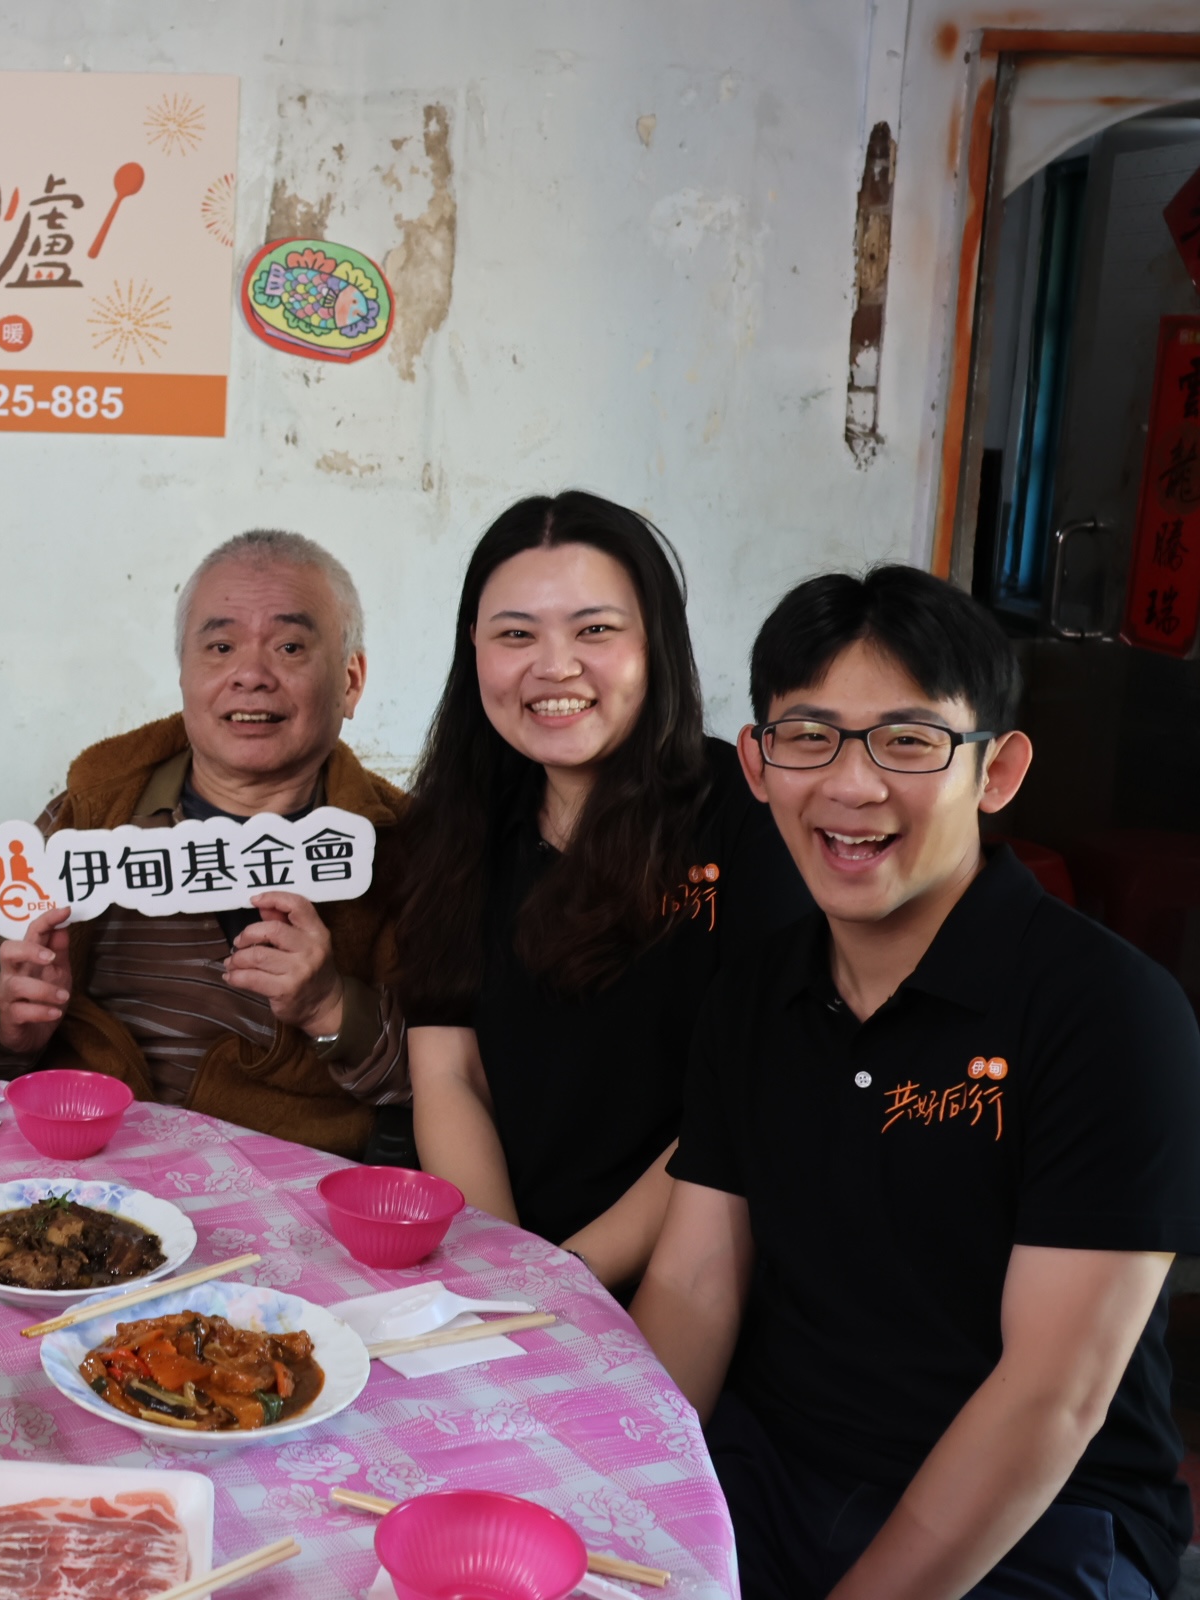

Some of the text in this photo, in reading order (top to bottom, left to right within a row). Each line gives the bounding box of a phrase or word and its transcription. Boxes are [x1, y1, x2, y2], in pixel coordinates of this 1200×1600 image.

[58, 827, 356, 903] 伊甸基金會
[971, 1060, 1003, 1077] 伊甸
[881, 1080, 1004, 1142] 共好同行
